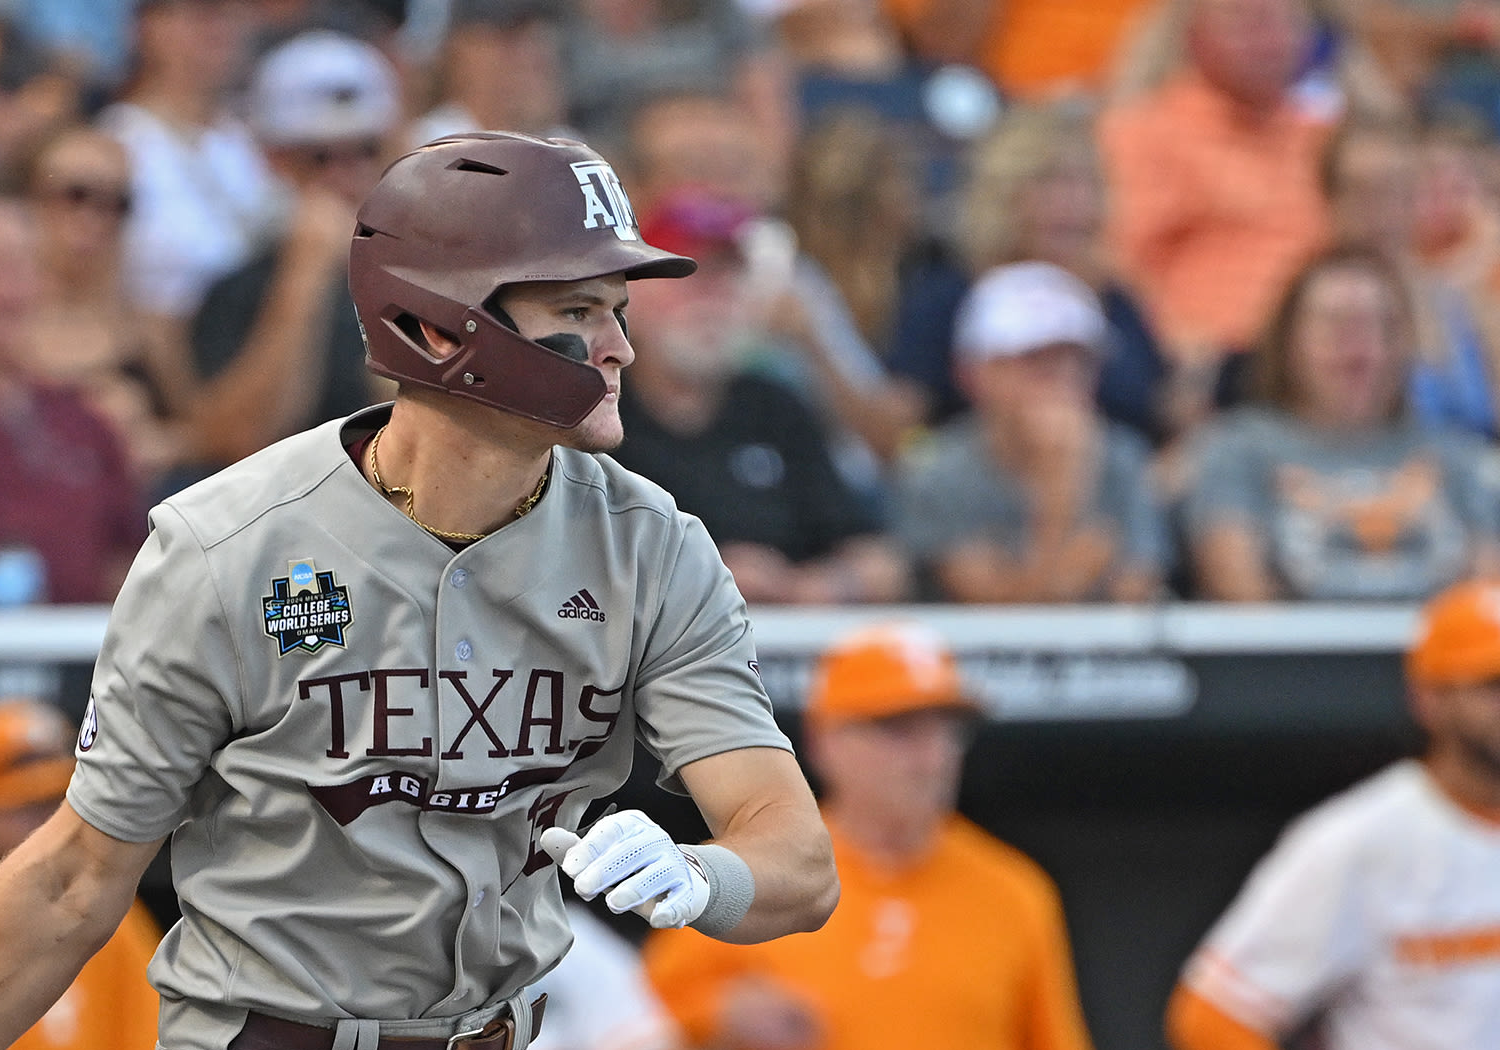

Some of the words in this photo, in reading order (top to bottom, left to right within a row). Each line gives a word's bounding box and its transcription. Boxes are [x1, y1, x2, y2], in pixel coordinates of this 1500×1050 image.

[283, 600, 330, 617] COLLEGE
[557, 607, 606, 622] adidas
[268, 615, 308, 633] WORLD
[310, 610, 349, 627] SERIES
[297, 628, 324, 636] OMAHA
[299, 669, 622, 760] TEXAS
